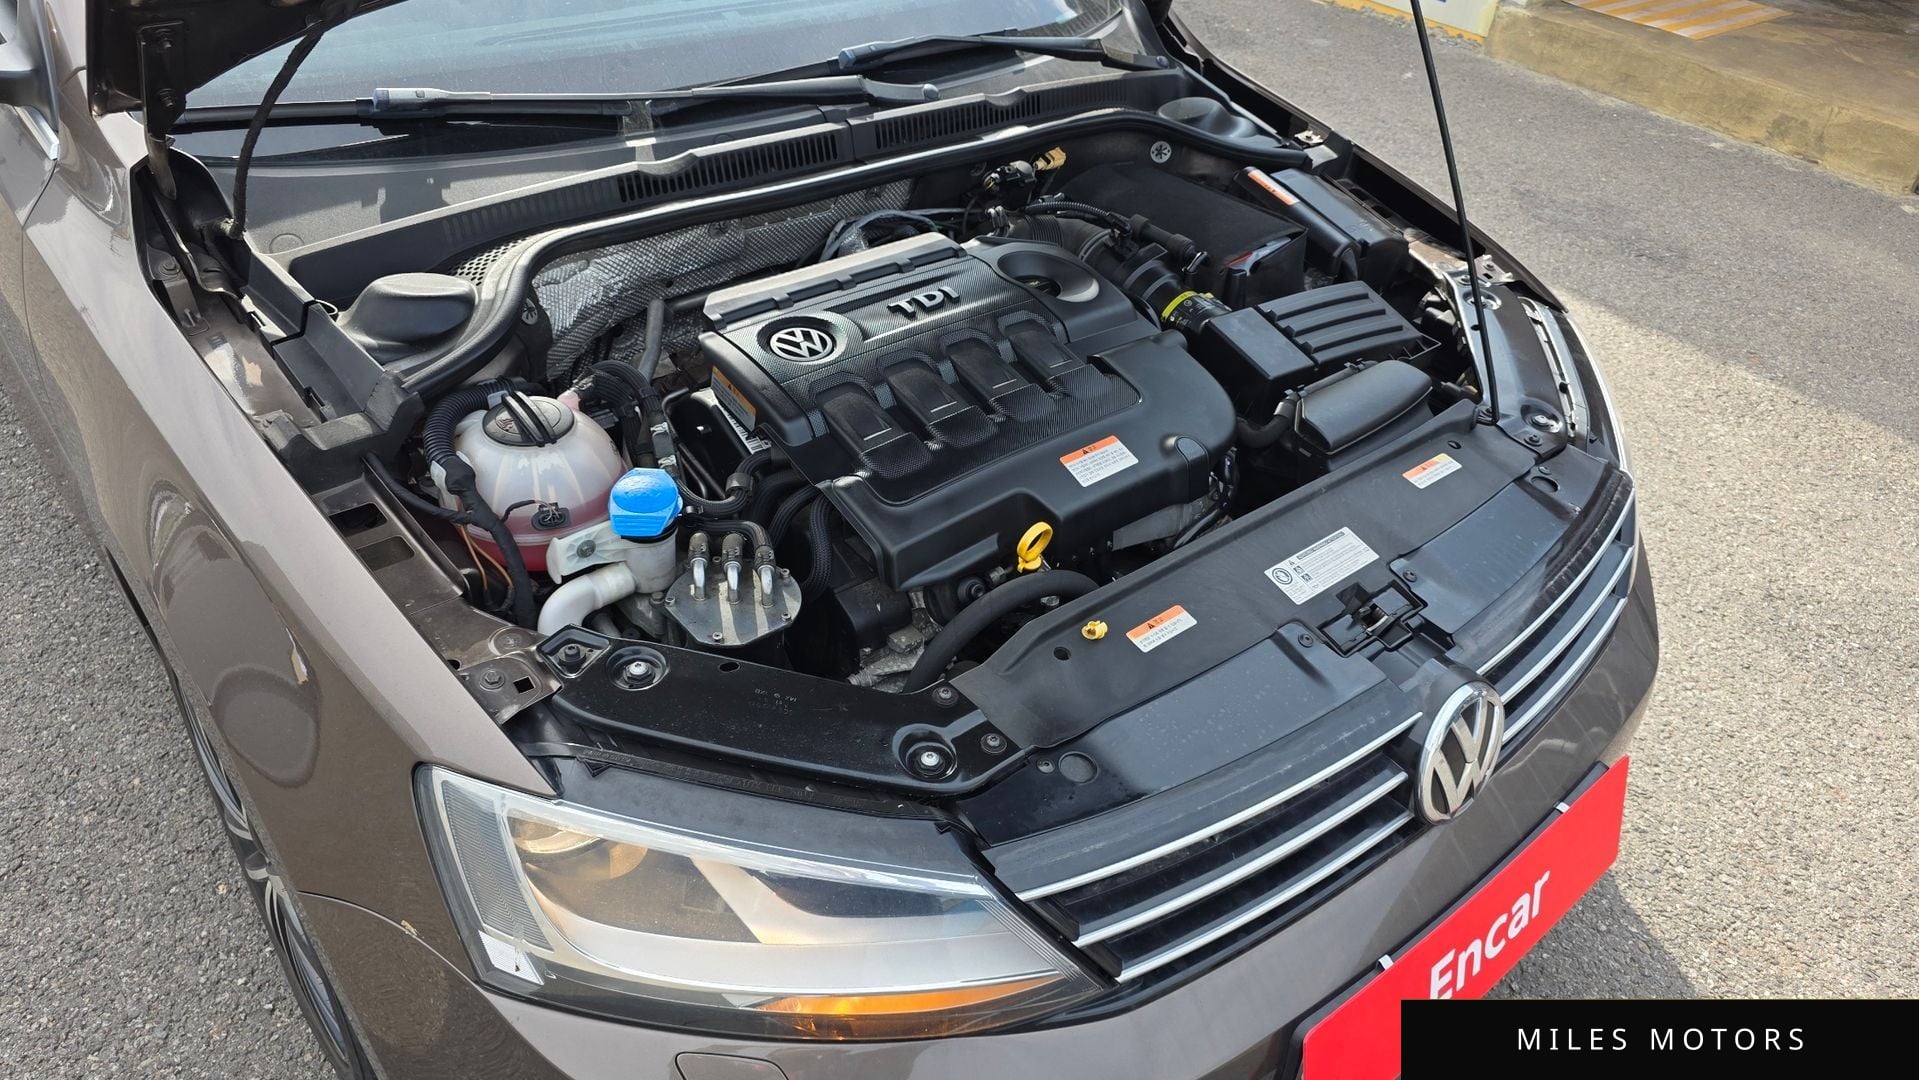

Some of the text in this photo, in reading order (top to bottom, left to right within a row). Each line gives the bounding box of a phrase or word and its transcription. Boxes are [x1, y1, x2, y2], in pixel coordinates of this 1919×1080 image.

[887, 286, 960, 319] TDI
[770, 327, 833, 362] VW
[1419, 682, 1504, 824] VW
[1429, 870, 1551, 1000] Encar
